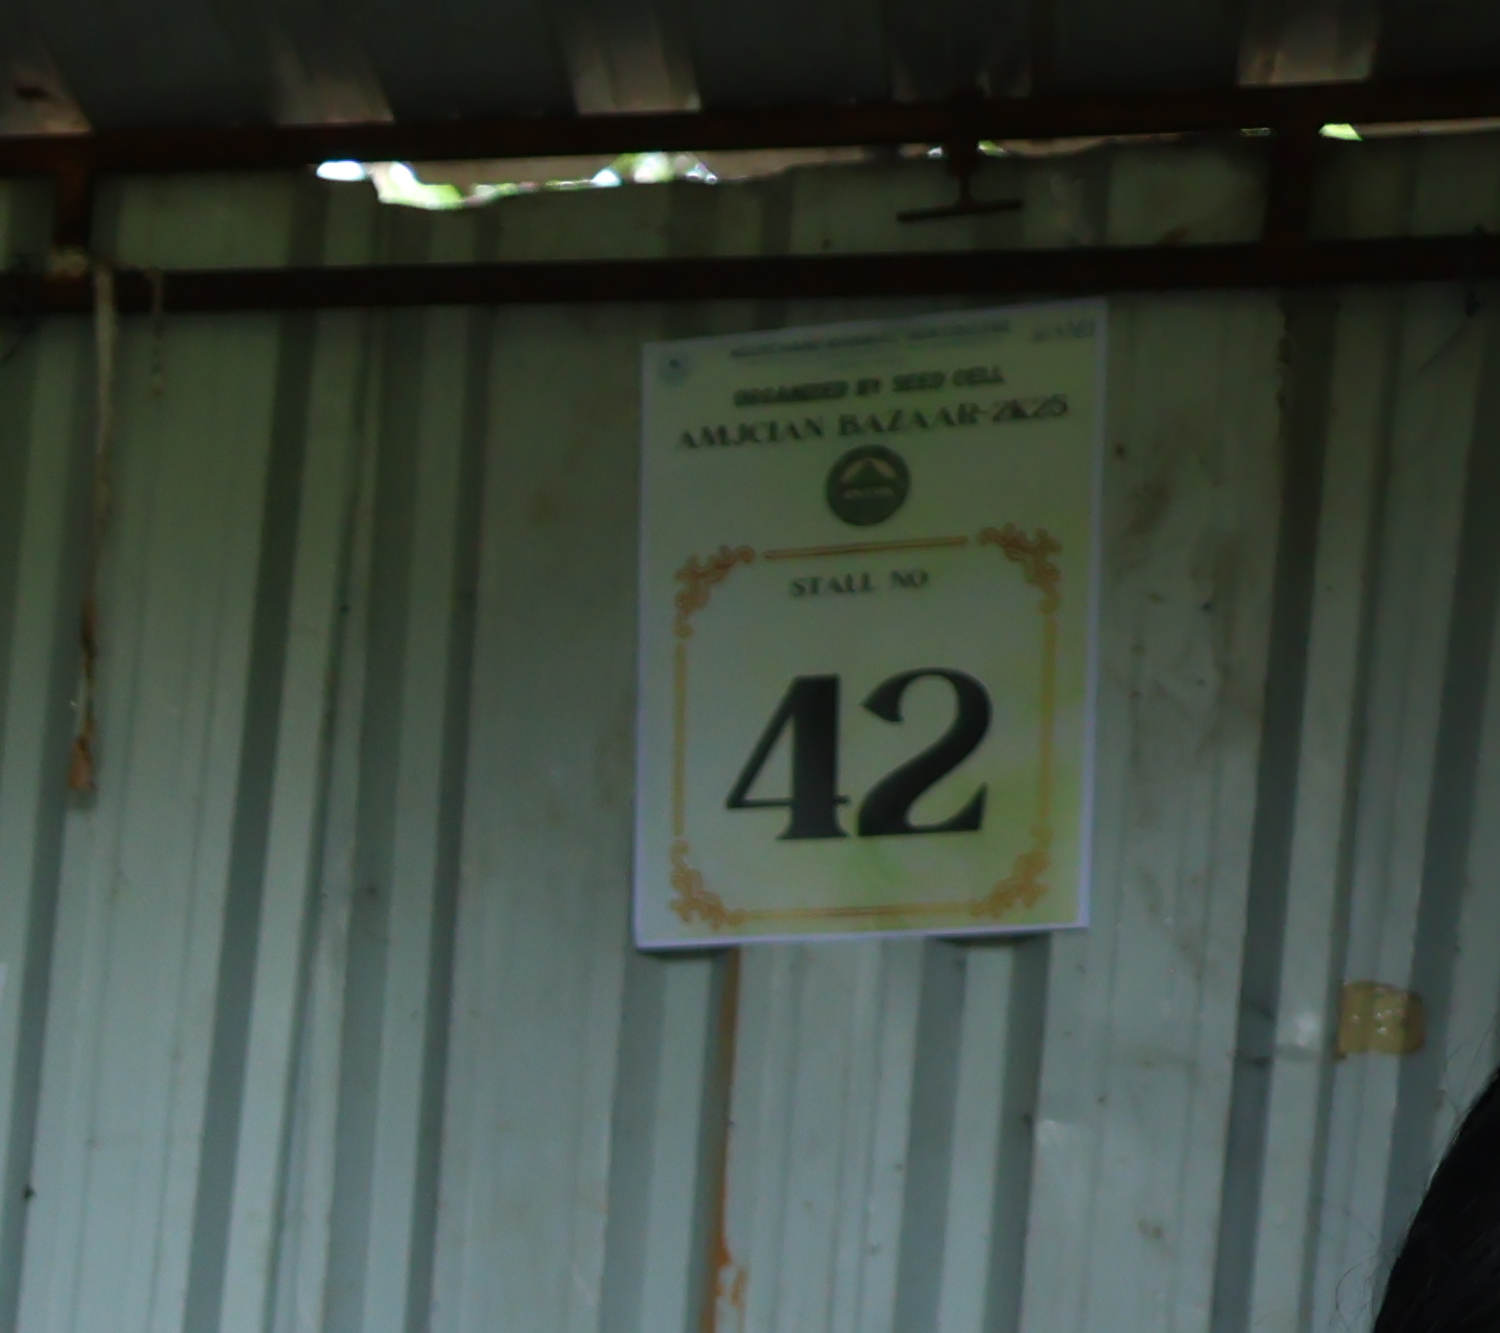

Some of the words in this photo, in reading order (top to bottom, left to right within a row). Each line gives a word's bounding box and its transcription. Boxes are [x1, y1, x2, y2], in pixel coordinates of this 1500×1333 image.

[676, 414, 823, 451] AMJCIAN
[789, 572, 876, 598] STALL
[890, 569, 929, 591] NO
[725, 665, 992, 842] 42
